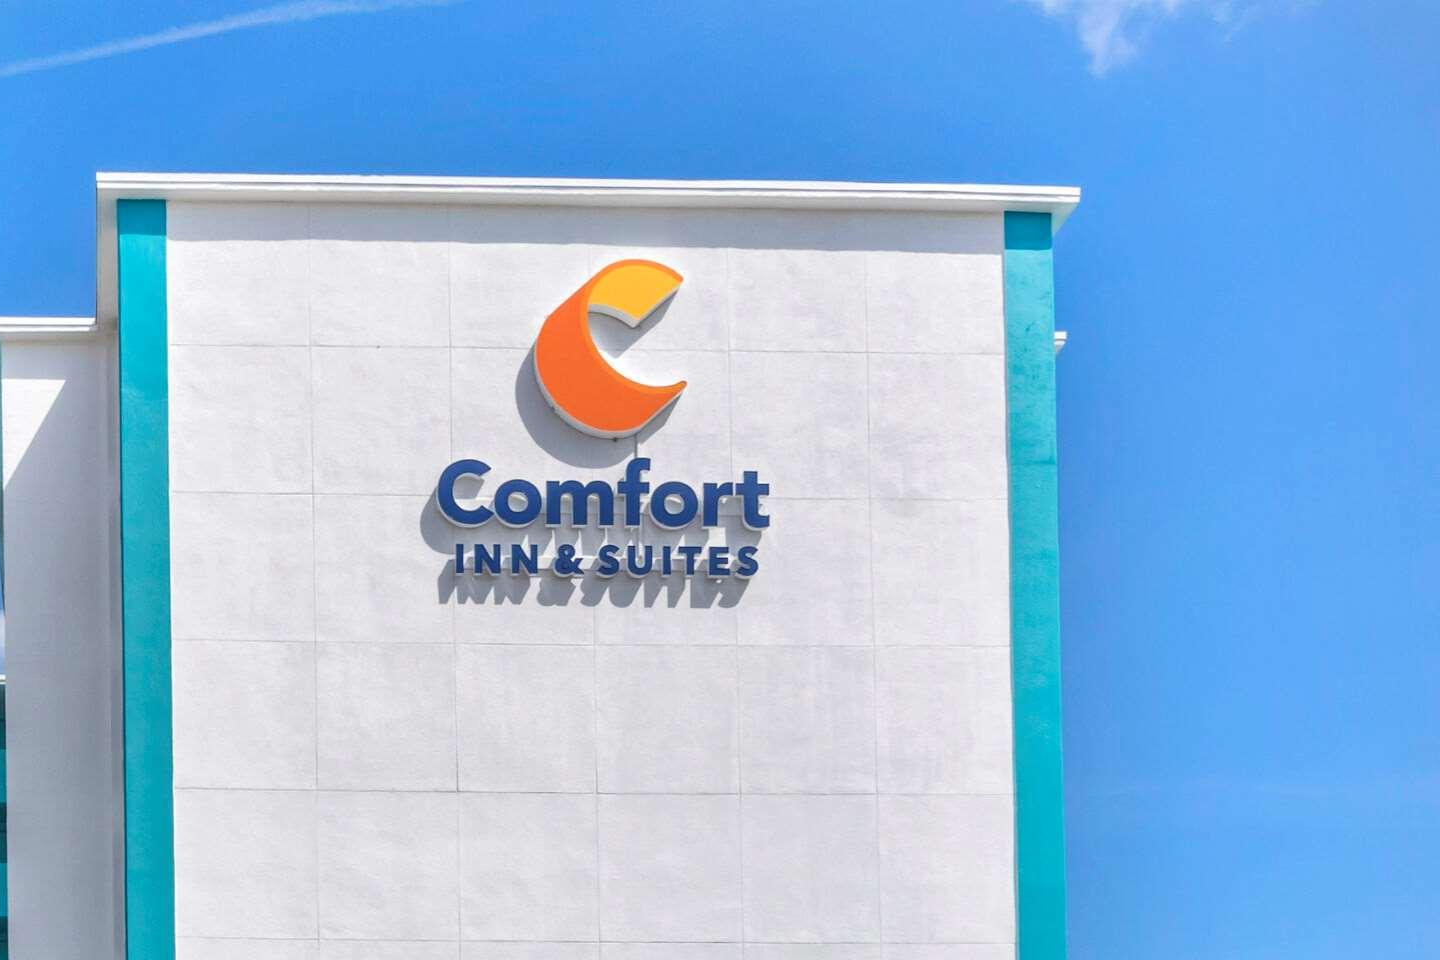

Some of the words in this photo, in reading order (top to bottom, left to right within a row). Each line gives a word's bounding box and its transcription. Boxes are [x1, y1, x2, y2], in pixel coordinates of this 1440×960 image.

[436, 457, 770, 529] Comfort
[455, 543, 539, 575] INN
[553, 543, 584, 576] &
[597, 544, 760, 577] SUITES
